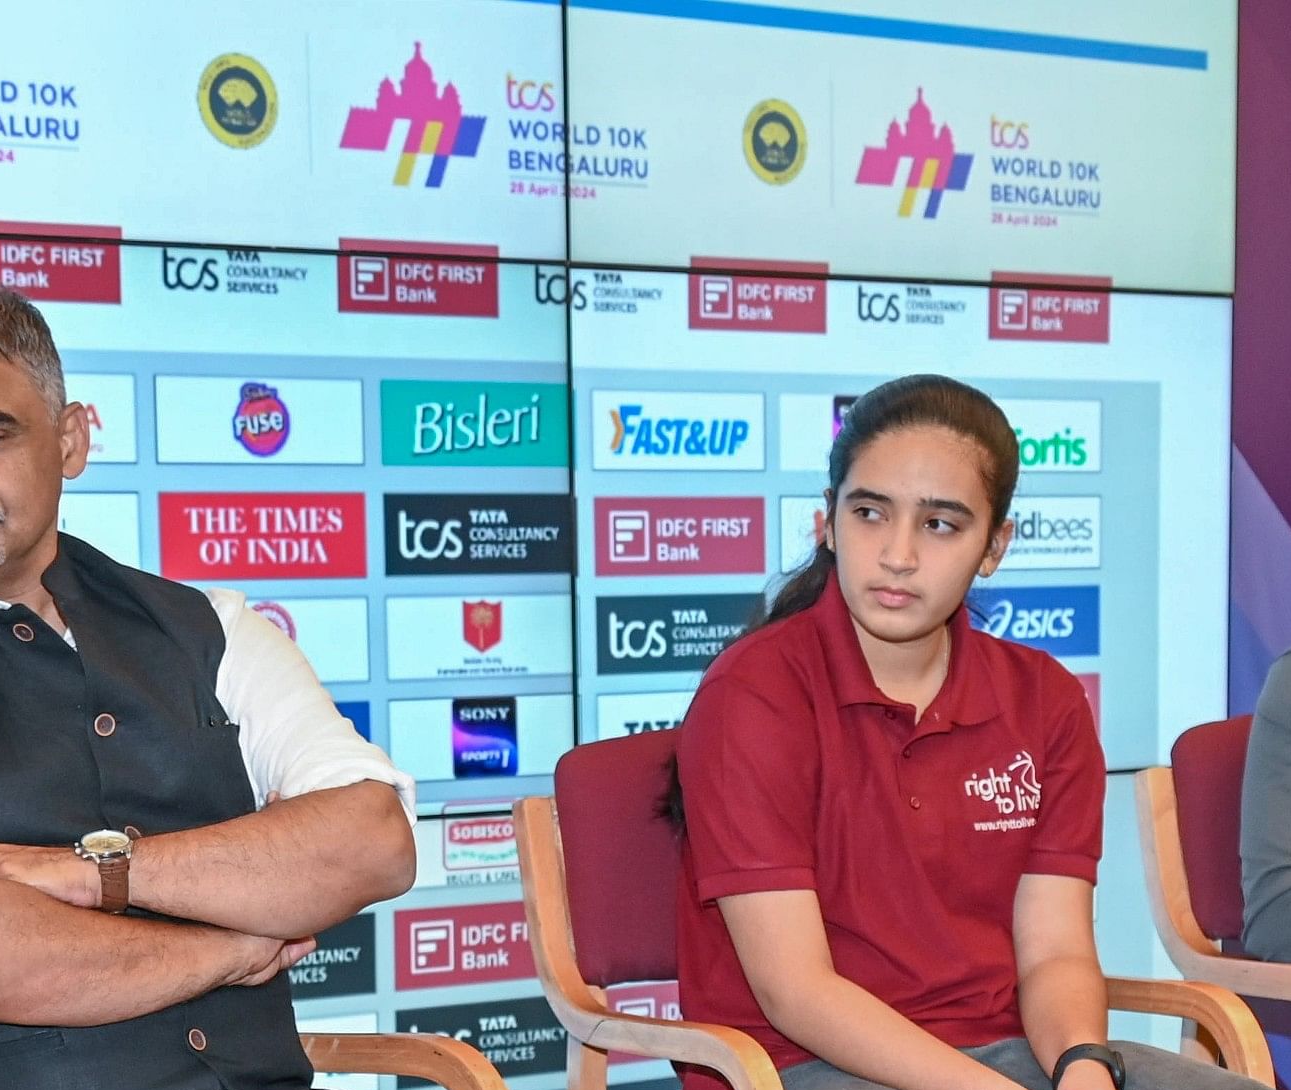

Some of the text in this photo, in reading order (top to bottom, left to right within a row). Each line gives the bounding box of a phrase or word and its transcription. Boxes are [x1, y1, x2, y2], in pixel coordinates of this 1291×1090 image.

[28, 83, 77, 108] 10K
[506, 71, 556, 112] tcs
[509, 119, 647, 149] WORLD 10K
[990, 115, 1030, 149] tcs
[509, 150, 649, 179] BENGALURU
[992, 157, 1100, 183] WORLD 10K
[991, 183, 1101, 209] BENGALURU
[0, 244, 105, 268] IDFC FIRST
[1, 268, 50, 289] Bank
[162, 247, 219, 293] tcs
[227, 265, 308, 284] CONSULTANCY
[394, 262, 485, 286] IDFC FIRST
[395, 284, 437, 305] Bank
[534, 266, 587, 311] tcs
[737, 283, 816, 304] IDFC FIRST
[738, 302, 774, 322] Bank
[858, 286, 901, 324] tcs
[1031, 296, 1100, 316] IDFC FIRST
[1032, 314, 1064, 332] Bank
[413, 393, 540, 455] Bisleri
[614, 405, 749, 456] FAST&UP
[184, 507, 343, 534] THE TIMES
[470, 510, 509, 526] TATA
[656, 517, 751, 538] IDFC FIRST
[1012, 512, 1094, 542] idbees
[398, 510, 464, 561] tcs
[470, 526, 560, 544] CONSULTANCY
[200, 539, 329, 566] OF INDIA
[470, 543, 528, 560] SERVICES
[657, 542, 701, 562] Bank
[672, 610, 708, 624] TATA
[1011, 606, 1075, 639] asics
[609, 612, 667, 658] tcs
[459, 707, 510, 722] SONY
[964, 768, 1012, 801] right
[995, 794, 1015, 814] to
[452, 822, 514, 841] SOBISCO
[461, 922, 506, 946] IDFC
[462, 949, 509, 970] Bank
[288, 966, 327, 984] VICES
[479, 1015, 517, 1031] TATA
[484, 1045, 536, 1063] ERVICES
